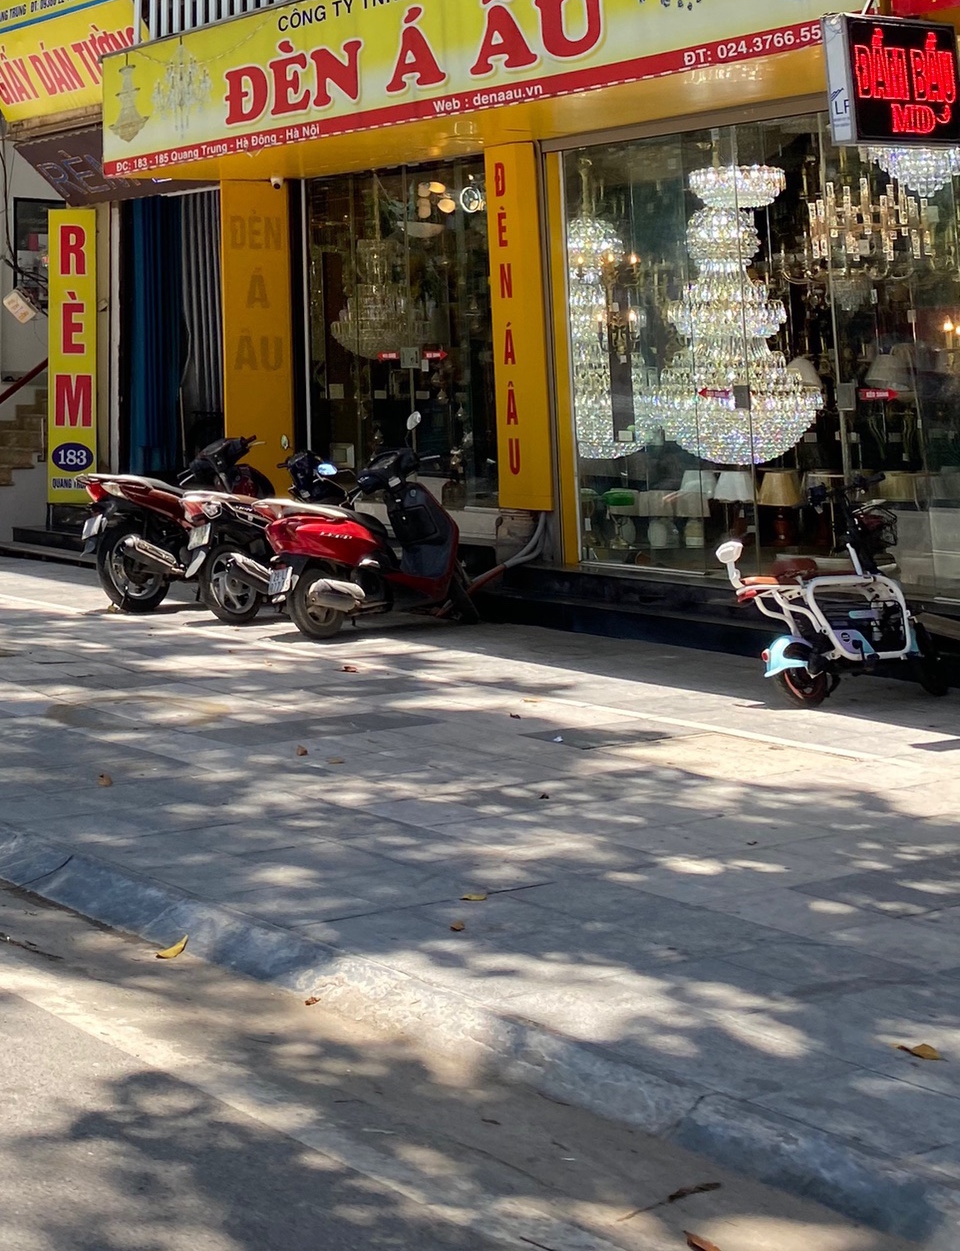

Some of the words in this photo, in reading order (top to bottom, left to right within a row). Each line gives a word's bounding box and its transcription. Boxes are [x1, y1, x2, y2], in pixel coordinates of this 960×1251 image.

[9, 4, 27, 19] TRUNG
[278, 6, 328, 32] CÔNG
[28, 41, 86, 96] DÁN
[225, 39, 362, 126] ĐÈN
[386, 6, 446, 93] Á
[683, 49, 712, 67] ĐT:
[433, 97, 461, 114] Web
[473, 84, 544, 107] denaau.vn
[134, 157, 147, 169] 183
[154, 152, 169, 164] 185
[171, 149, 199, 162] Quang
[200, 143, 228, 156] Trung
[251, 133, 277, 147] Đông
[286, 129, 300, 140] Hà
[302, 126, 320, 139] Nội
[55, 224, 93, 427] RÈM
[58, 449, 87, 466] 183
